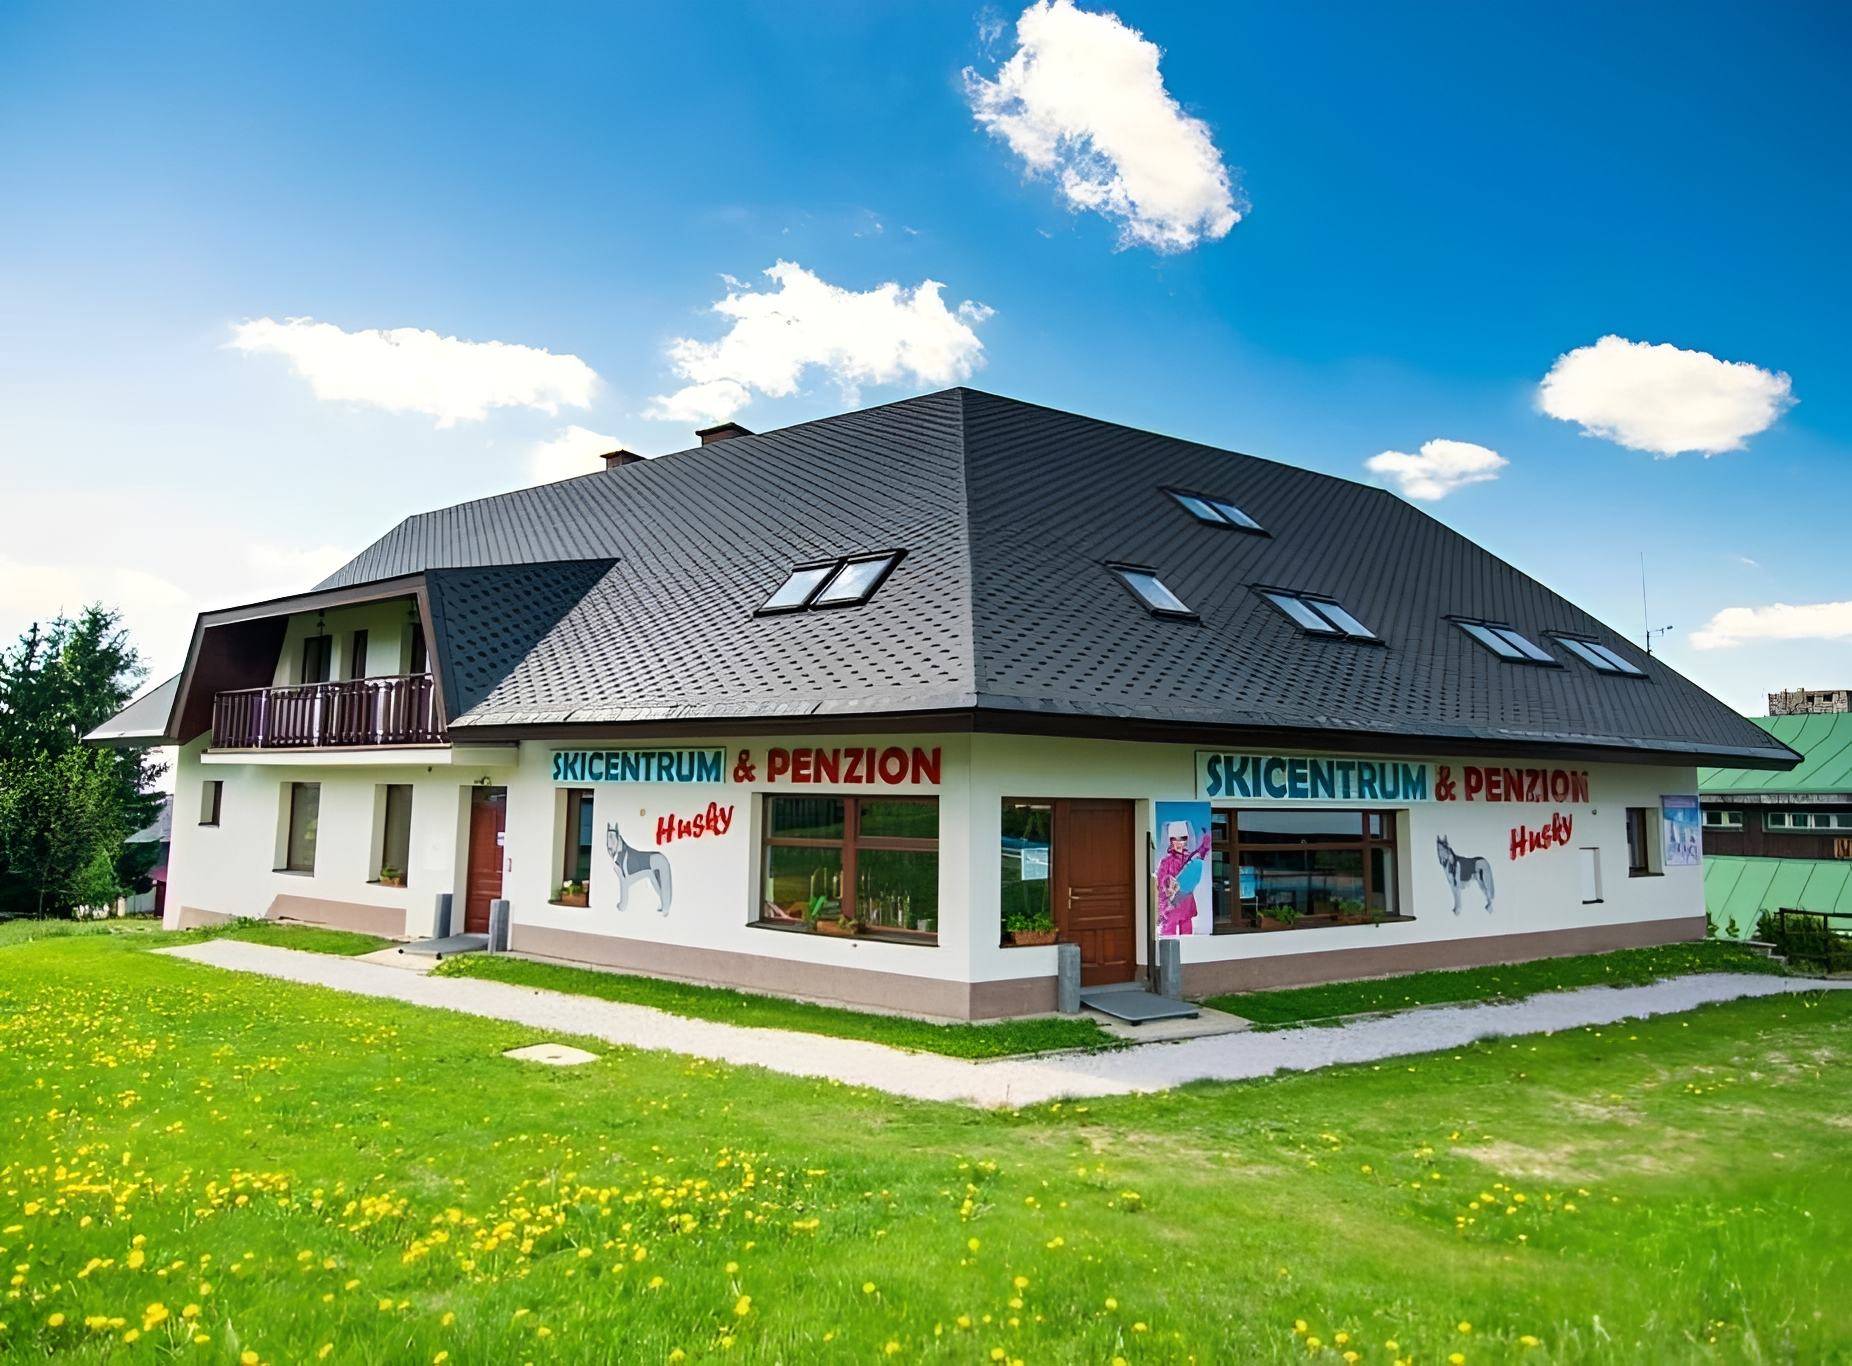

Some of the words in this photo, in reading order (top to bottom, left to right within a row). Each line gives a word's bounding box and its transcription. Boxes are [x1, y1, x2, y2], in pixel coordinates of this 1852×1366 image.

[553, 749, 722, 783] SKICENTRUM
[733, 749, 756, 783] &
[767, 746, 942, 785] PENZION
[1206, 753, 1427, 800] SKICENTRUM
[1435, 765, 1457, 801] &
[1463, 766, 1590, 803] PENZION
